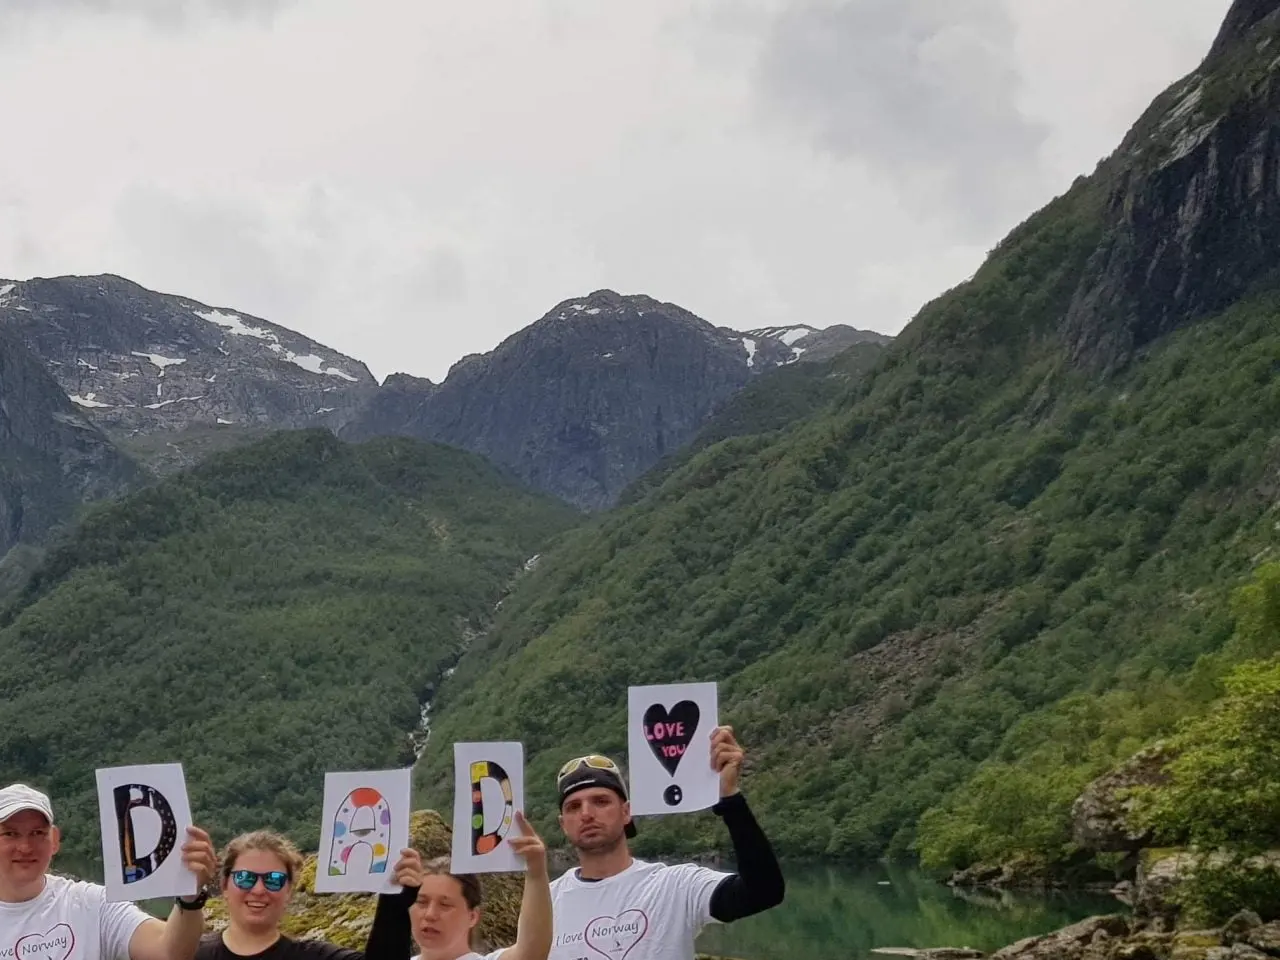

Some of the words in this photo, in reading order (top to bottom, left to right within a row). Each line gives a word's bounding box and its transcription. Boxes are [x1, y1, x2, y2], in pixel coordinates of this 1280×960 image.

[644, 722, 686, 740] LOVE
[662, 744, 686, 757] YOU
[113, 784, 178, 884] D
[328, 787, 392, 876] A
[470, 760, 513, 857] D
[562, 932, 583, 944] love
[592, 922, 639, 938] Norway
[22, 936, 67, 955] Norway
